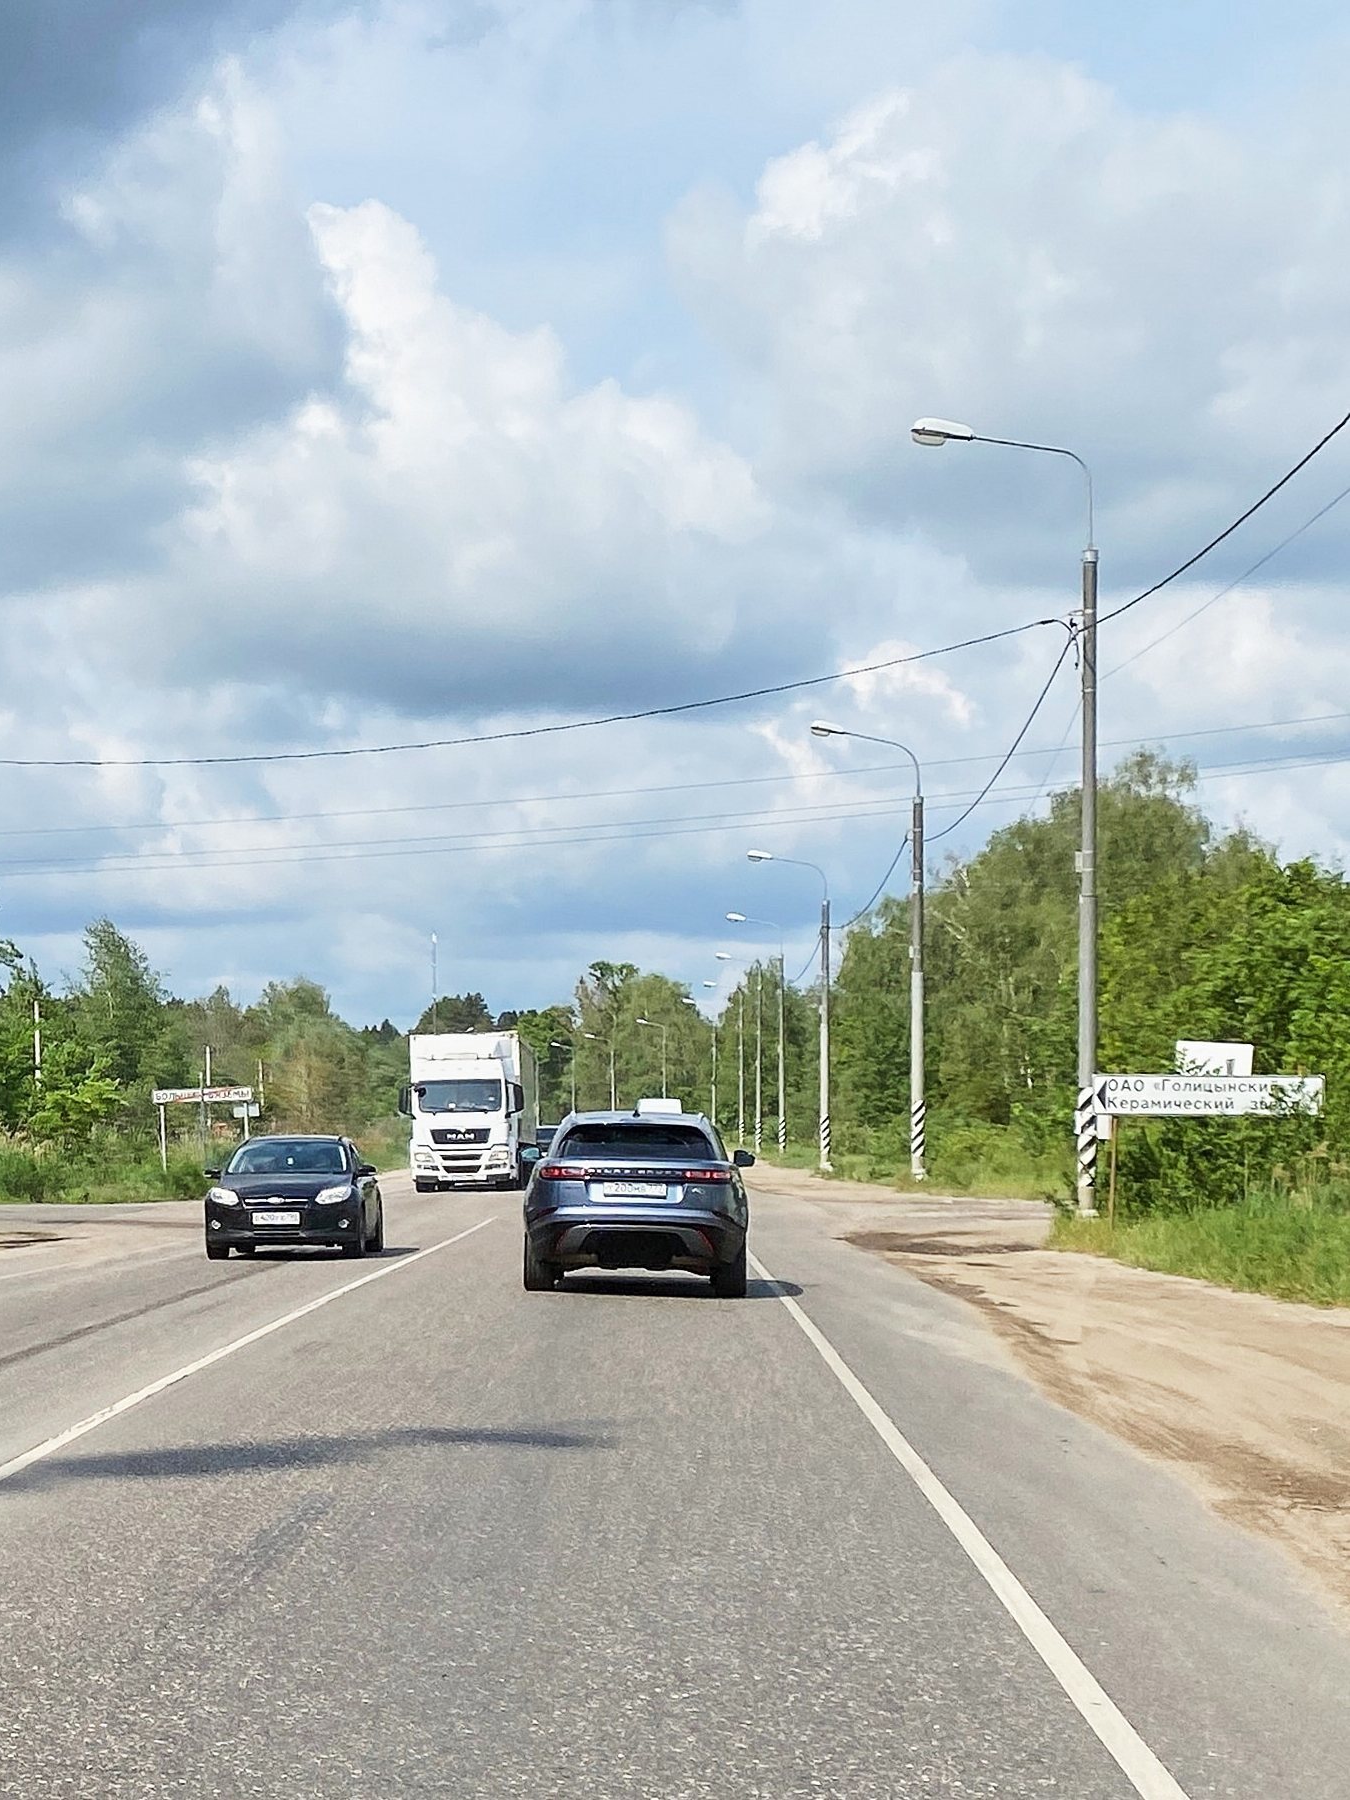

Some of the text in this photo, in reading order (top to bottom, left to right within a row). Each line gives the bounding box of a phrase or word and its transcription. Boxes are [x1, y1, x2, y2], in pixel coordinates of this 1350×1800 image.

[1108, 1079, 1145, 1092] ОАО
[1107, 1096, 1235, 1111] Керамический
[446, 1133, 475, 1141] MAN
